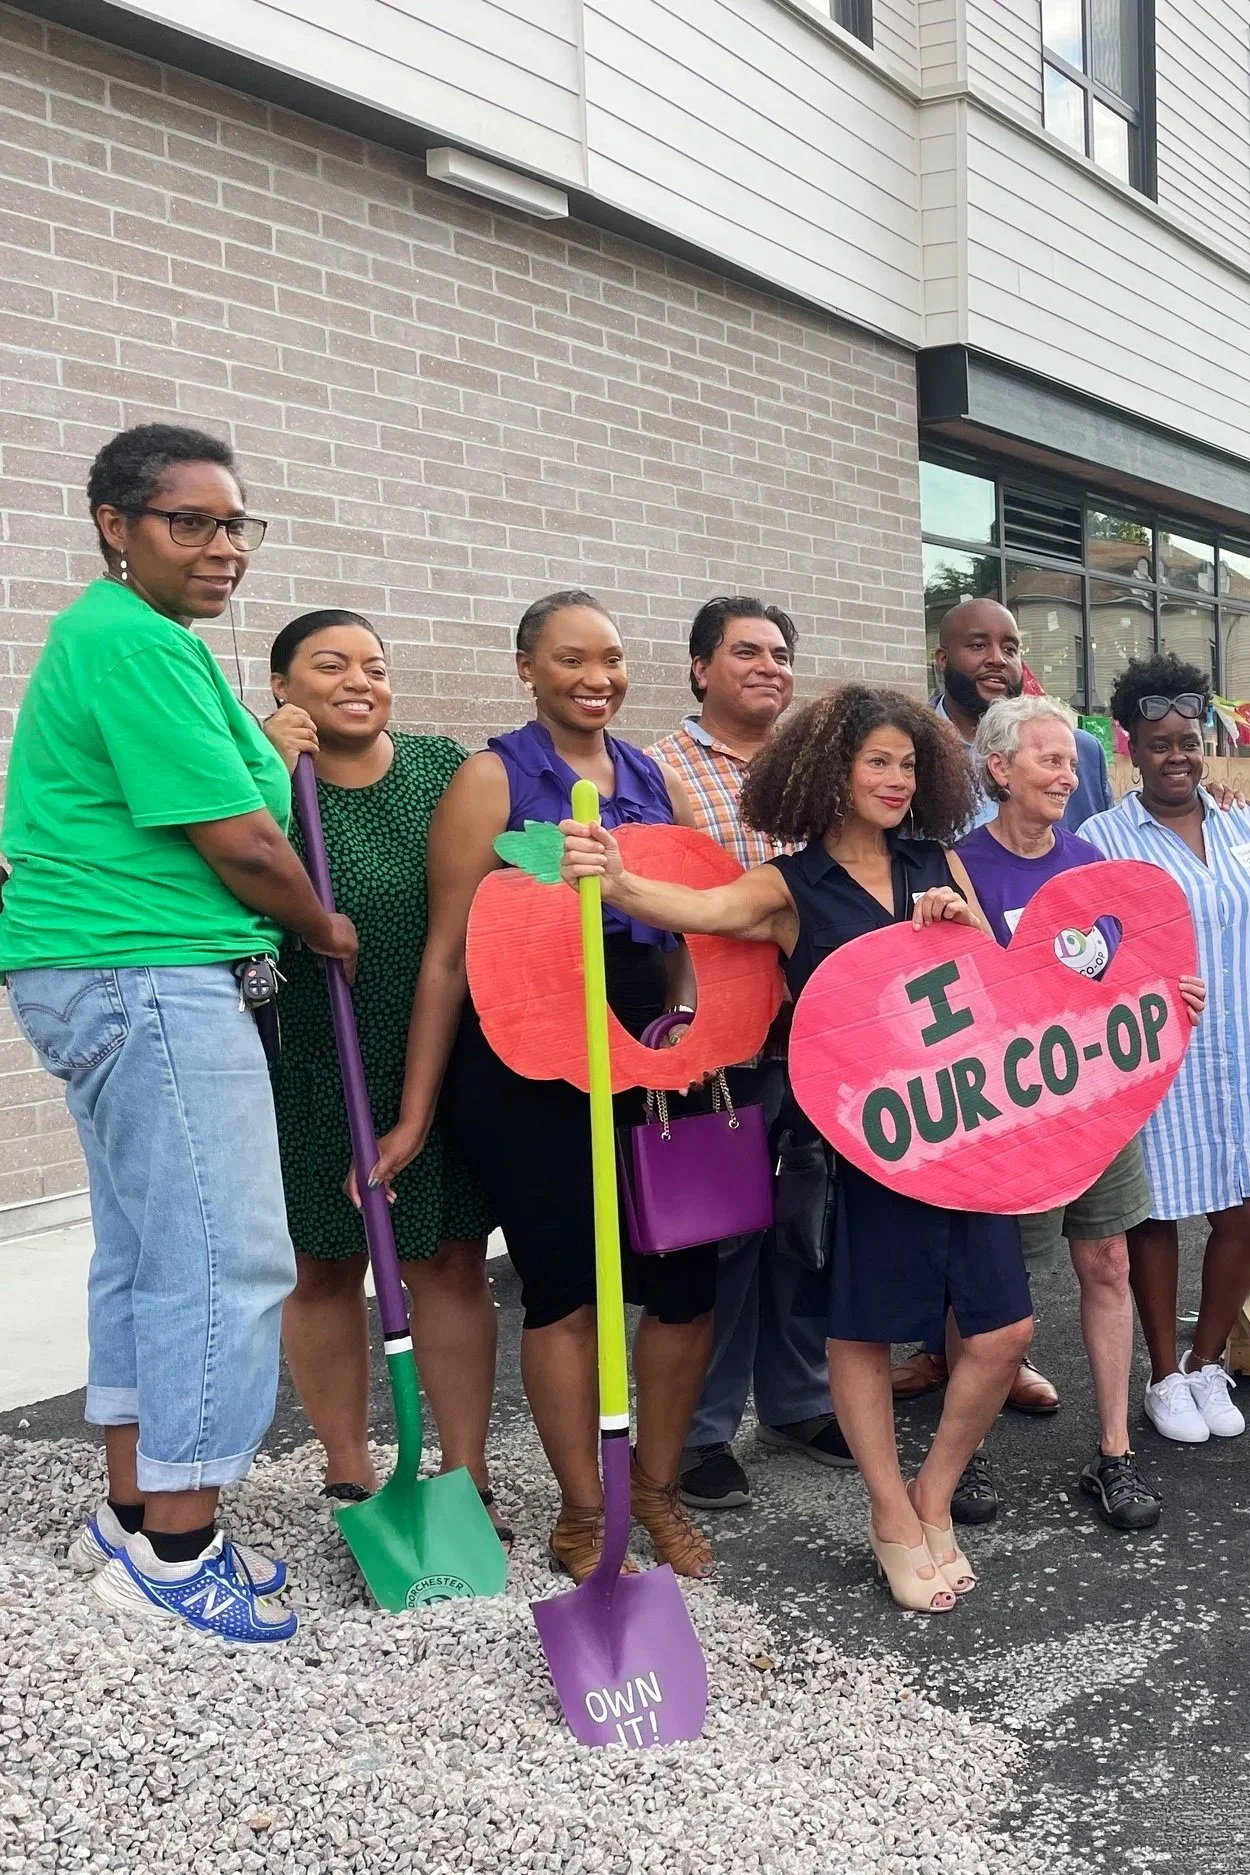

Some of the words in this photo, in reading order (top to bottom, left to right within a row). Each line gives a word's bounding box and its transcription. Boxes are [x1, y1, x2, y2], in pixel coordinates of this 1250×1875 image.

[903, 959, 976, 1048] I
[861, 1055, 1004, 1163] OUR
[1002, 992, 1169, 1109] CO-OP
[407, 1577, 465, 1609] DORCHESTER
[585, 1670, 663, 1723] OWN
[615, 1710, 660, 1748] IT!
